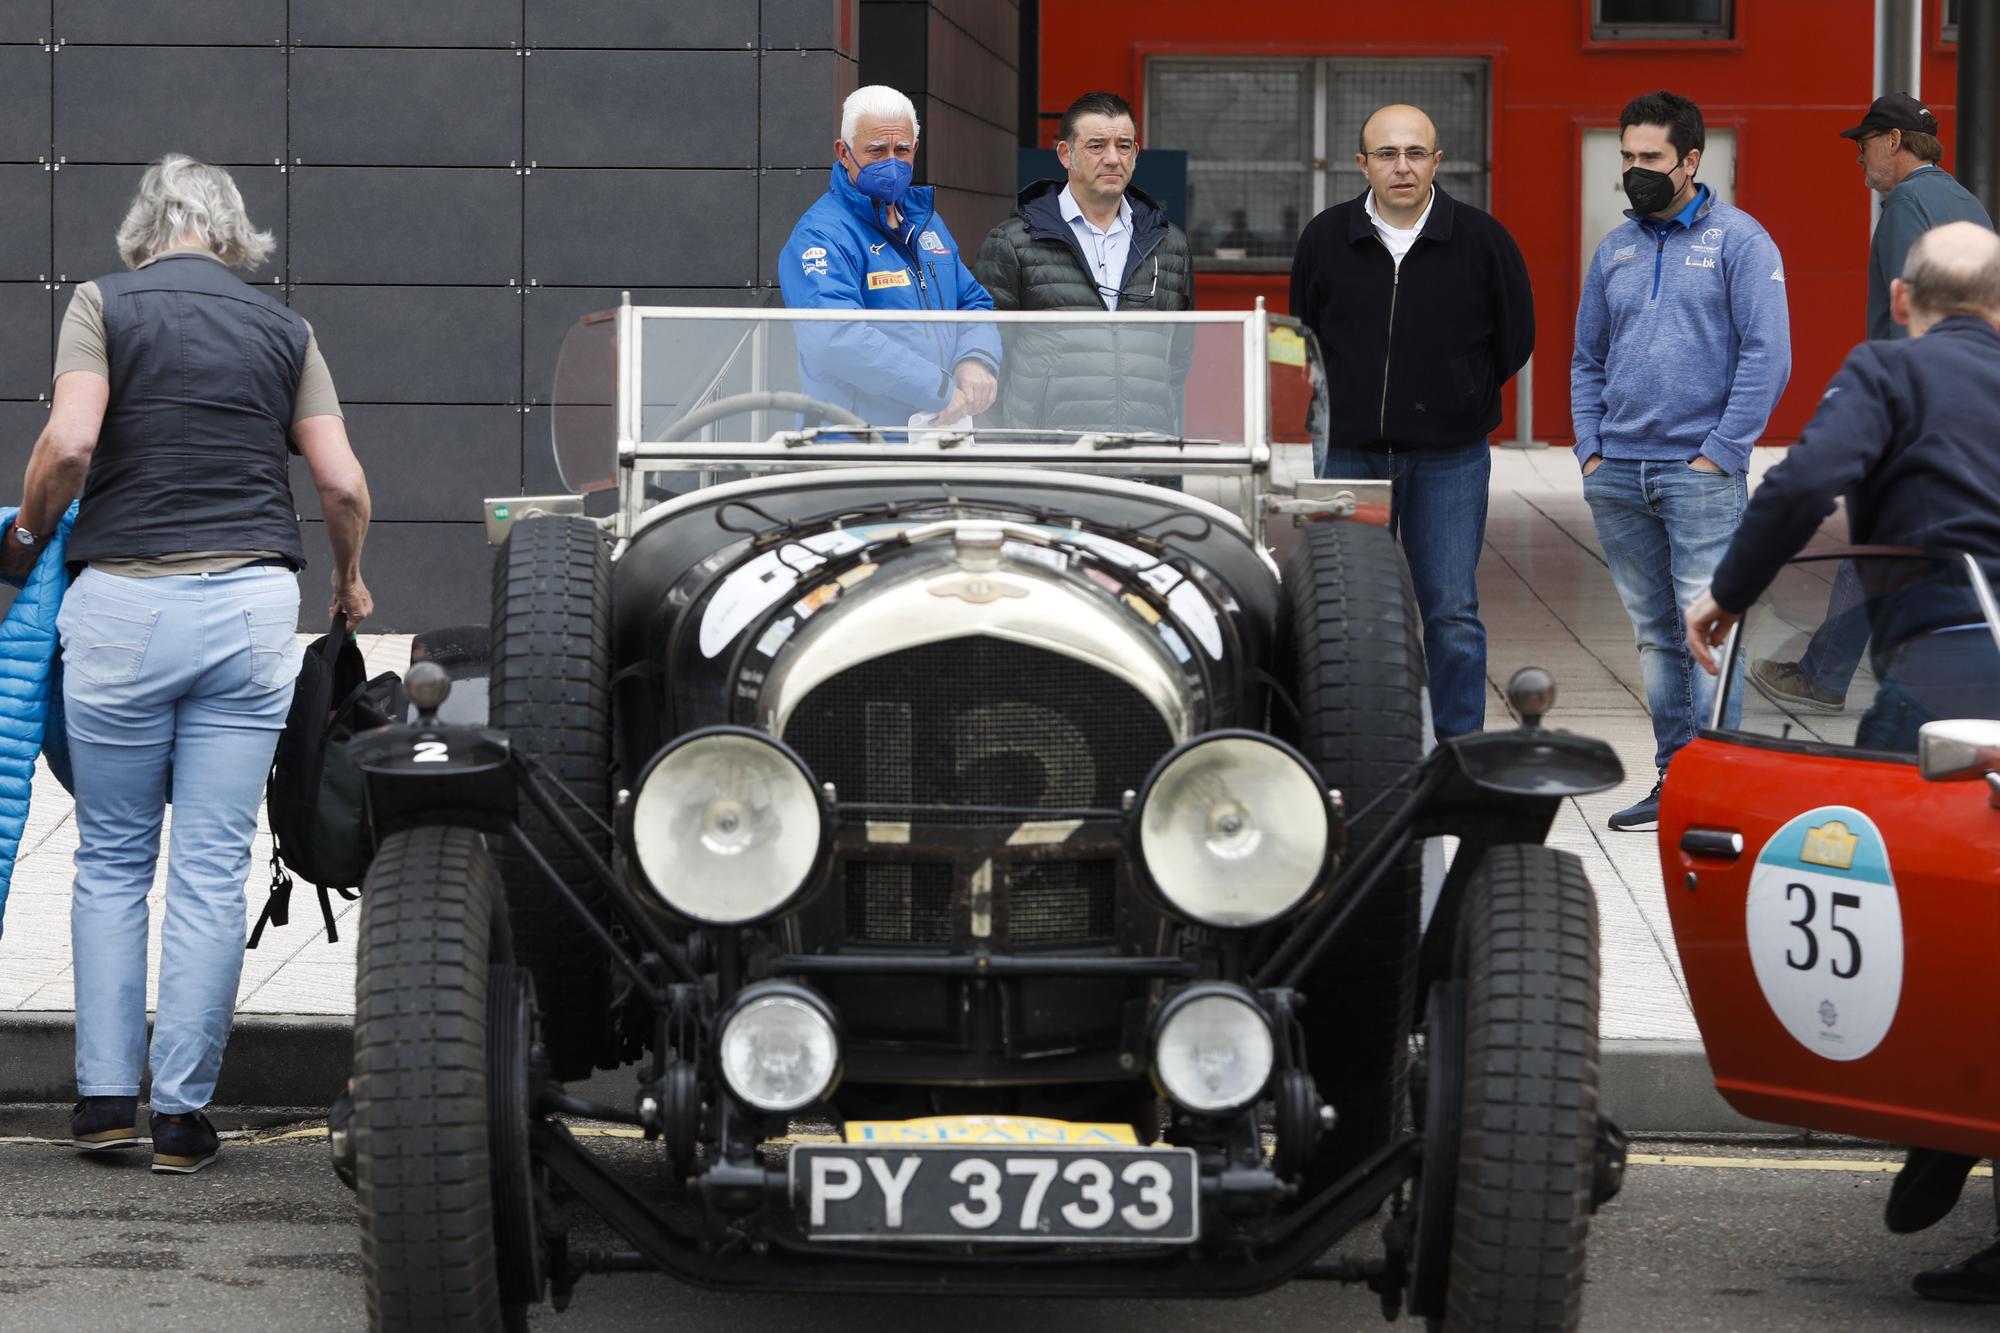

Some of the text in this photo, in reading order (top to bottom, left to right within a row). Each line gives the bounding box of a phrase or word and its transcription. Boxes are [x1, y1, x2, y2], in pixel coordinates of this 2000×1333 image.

[871, 273, 905, 286] PIRELLI
[412, 741, 449, 762] 2
[1786, 882, 1862, 979] 35
[810, 1156, 1174, 1231] PY 3733
